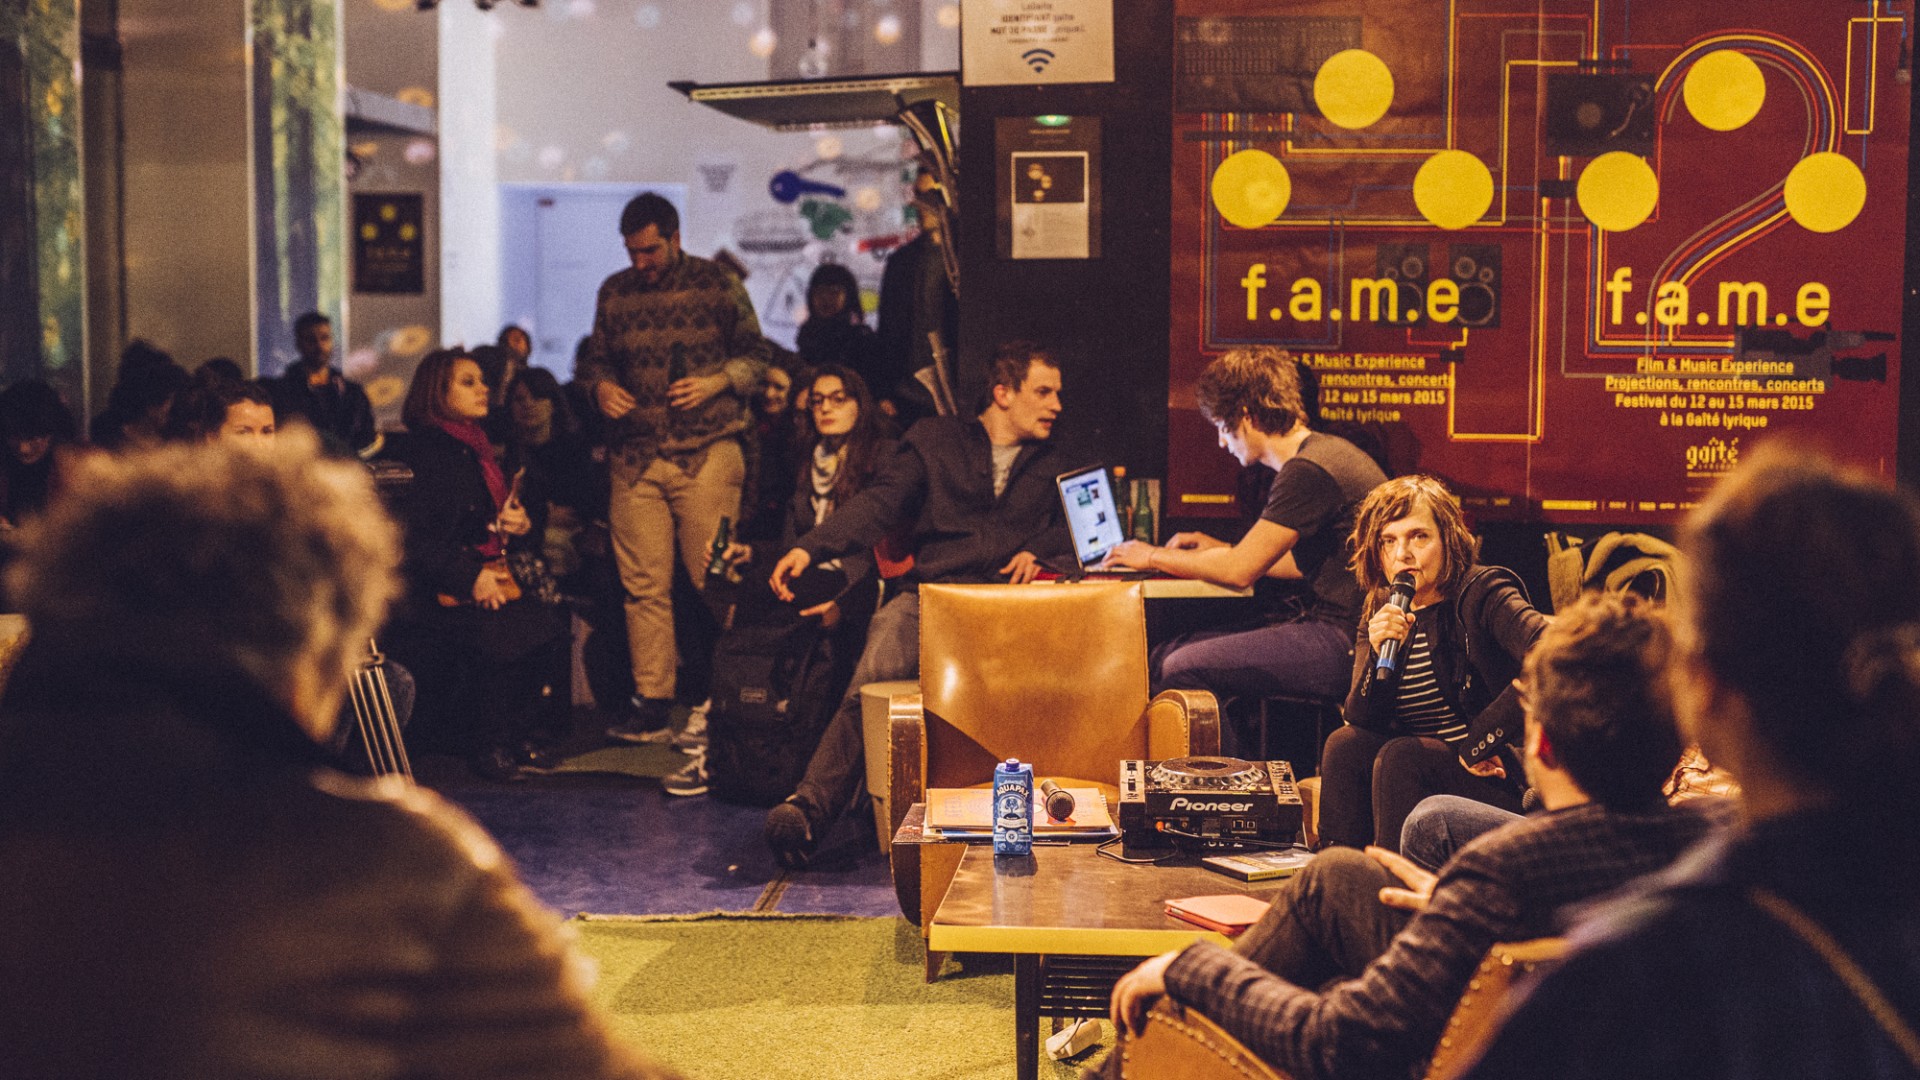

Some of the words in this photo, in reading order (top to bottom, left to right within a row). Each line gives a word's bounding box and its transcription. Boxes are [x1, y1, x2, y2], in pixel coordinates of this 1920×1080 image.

[1241, 263, 1460, 323] f.a.m.e
[1606, 267, 1831, 327] f.a.m.e
[1314, 353, 1351, 368] Music
[1354, 354, 1426, 370] Experience
[1637, 357, 1664, 373] Film
[1667, 358, 1677, 373] &
[1680, 358, 1718, 374] Music
[1721, 358, 1794, 376] Experience
[1321, 373, 1395, 387] rencontres,
[1605, 375, 1684, 392] Projections,
[1687, 377, 1763, 392] rencontres,
[1766, 378, 1825, 392] concerts
[1325, 389, 1340, 403] 12
[1342, 392, 1359, 404] au
[1362, 390, 1377, 404] 15
[1379, 392, 1412, 405] mars
[1413, 390, 1446, 405] 2015
[1615, 393, 1668, 408] Festival
[1669, 394, 1687, 409] du
[1690, 395, 1706, 409] 12
[1708, 397, 1725, 409] au
[1729, 395, 1744, 409] 15
[1747, 397, 1779, 410] mars
[1782, 396, 1815, 410] 2015
[1356, 408, 1401, 424] lyrique
[1660, 411, 1669, 426] à
[1671, 412, 1683, 426] la
[1722, 413, 1768, 430] lyrique
[997, 783, 1030, 798] AQUAPAX
[1169, 797, 1253, 812] Pioneer
